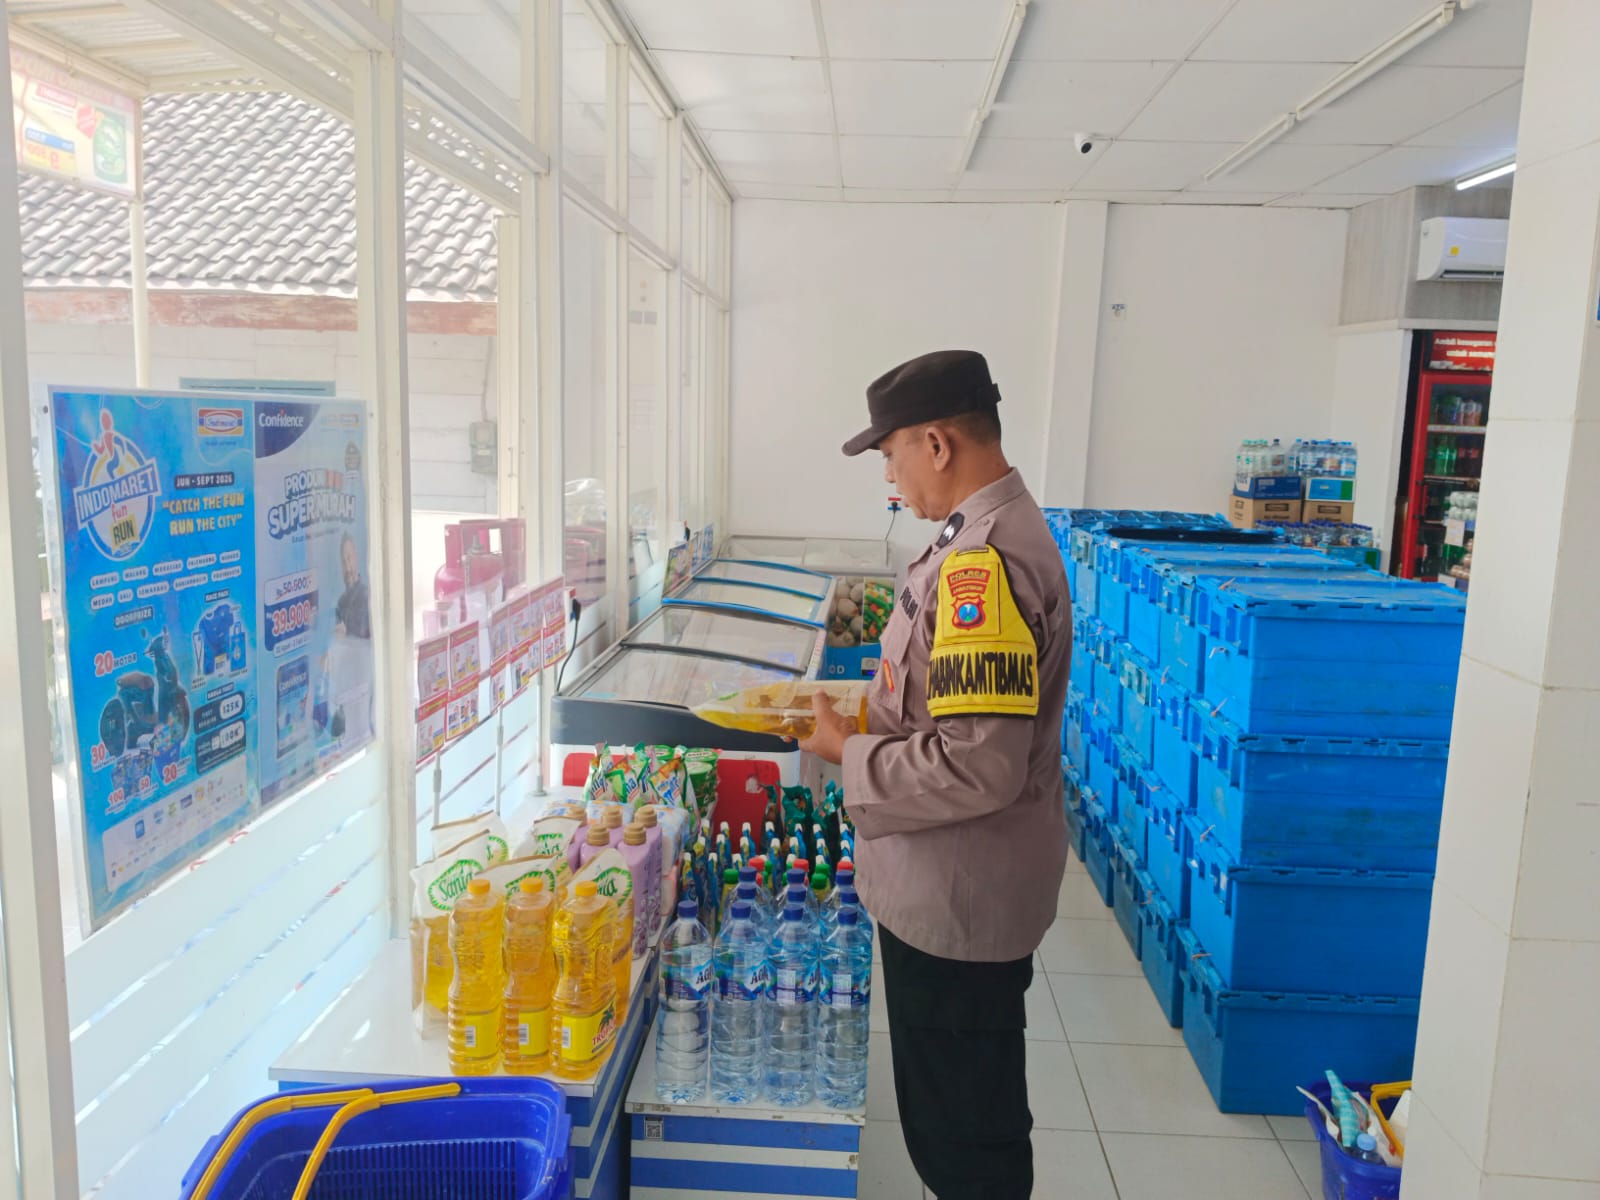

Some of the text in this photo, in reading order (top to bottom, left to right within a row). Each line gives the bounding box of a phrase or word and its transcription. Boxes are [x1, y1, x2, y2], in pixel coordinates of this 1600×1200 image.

[259, 411, 304, 427] Confidence
[78, 466, 155, 520] INDOMARET
[176, 477, 190, 488] JUN
[197, 475, 214, 486] SEPT
[203, 496, 222, 510] THE
[113, 519, 135, 546] RUN
[169, 518, 194, 536] RUN
[196, 516, 215, 532] THE
[94, 651, 137, 677] 20 MOTOR
[928, 651, 1034, 700] HABINKAMTIBMAS
[163, 762, 177, 785] 20
[438, 865, 473, 902] Sania
